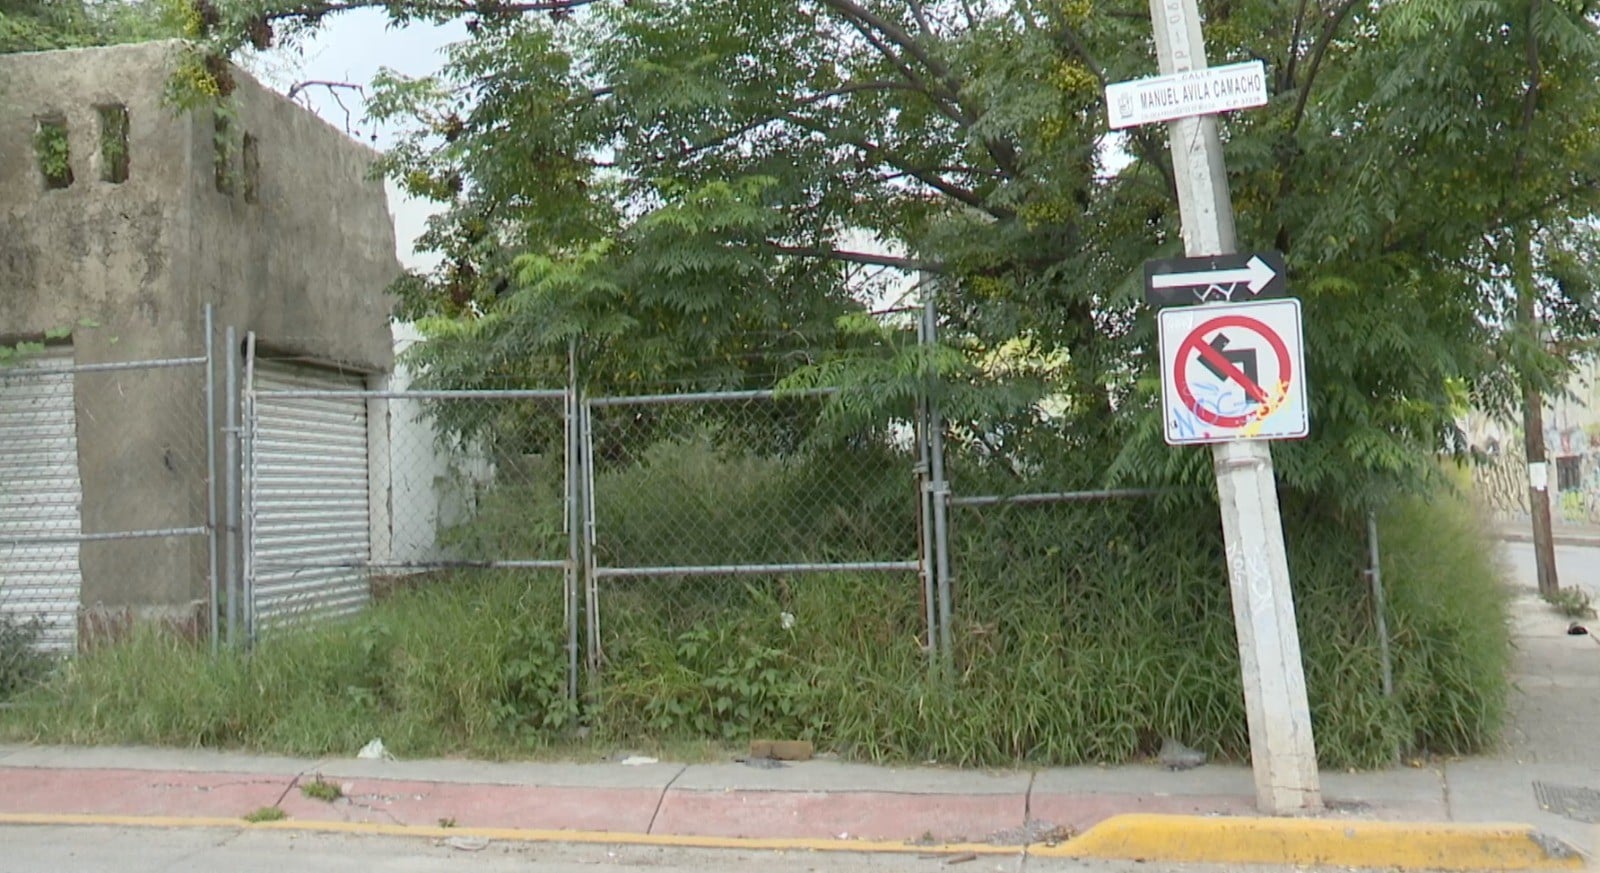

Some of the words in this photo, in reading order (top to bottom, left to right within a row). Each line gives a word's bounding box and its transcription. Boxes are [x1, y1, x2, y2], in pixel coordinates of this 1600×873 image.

[1140, 88, 1180, 110] MANUEL
[1183, 82, 1211, 102] AVILA
[1213, 74, 1261, 98] CAMACHO
